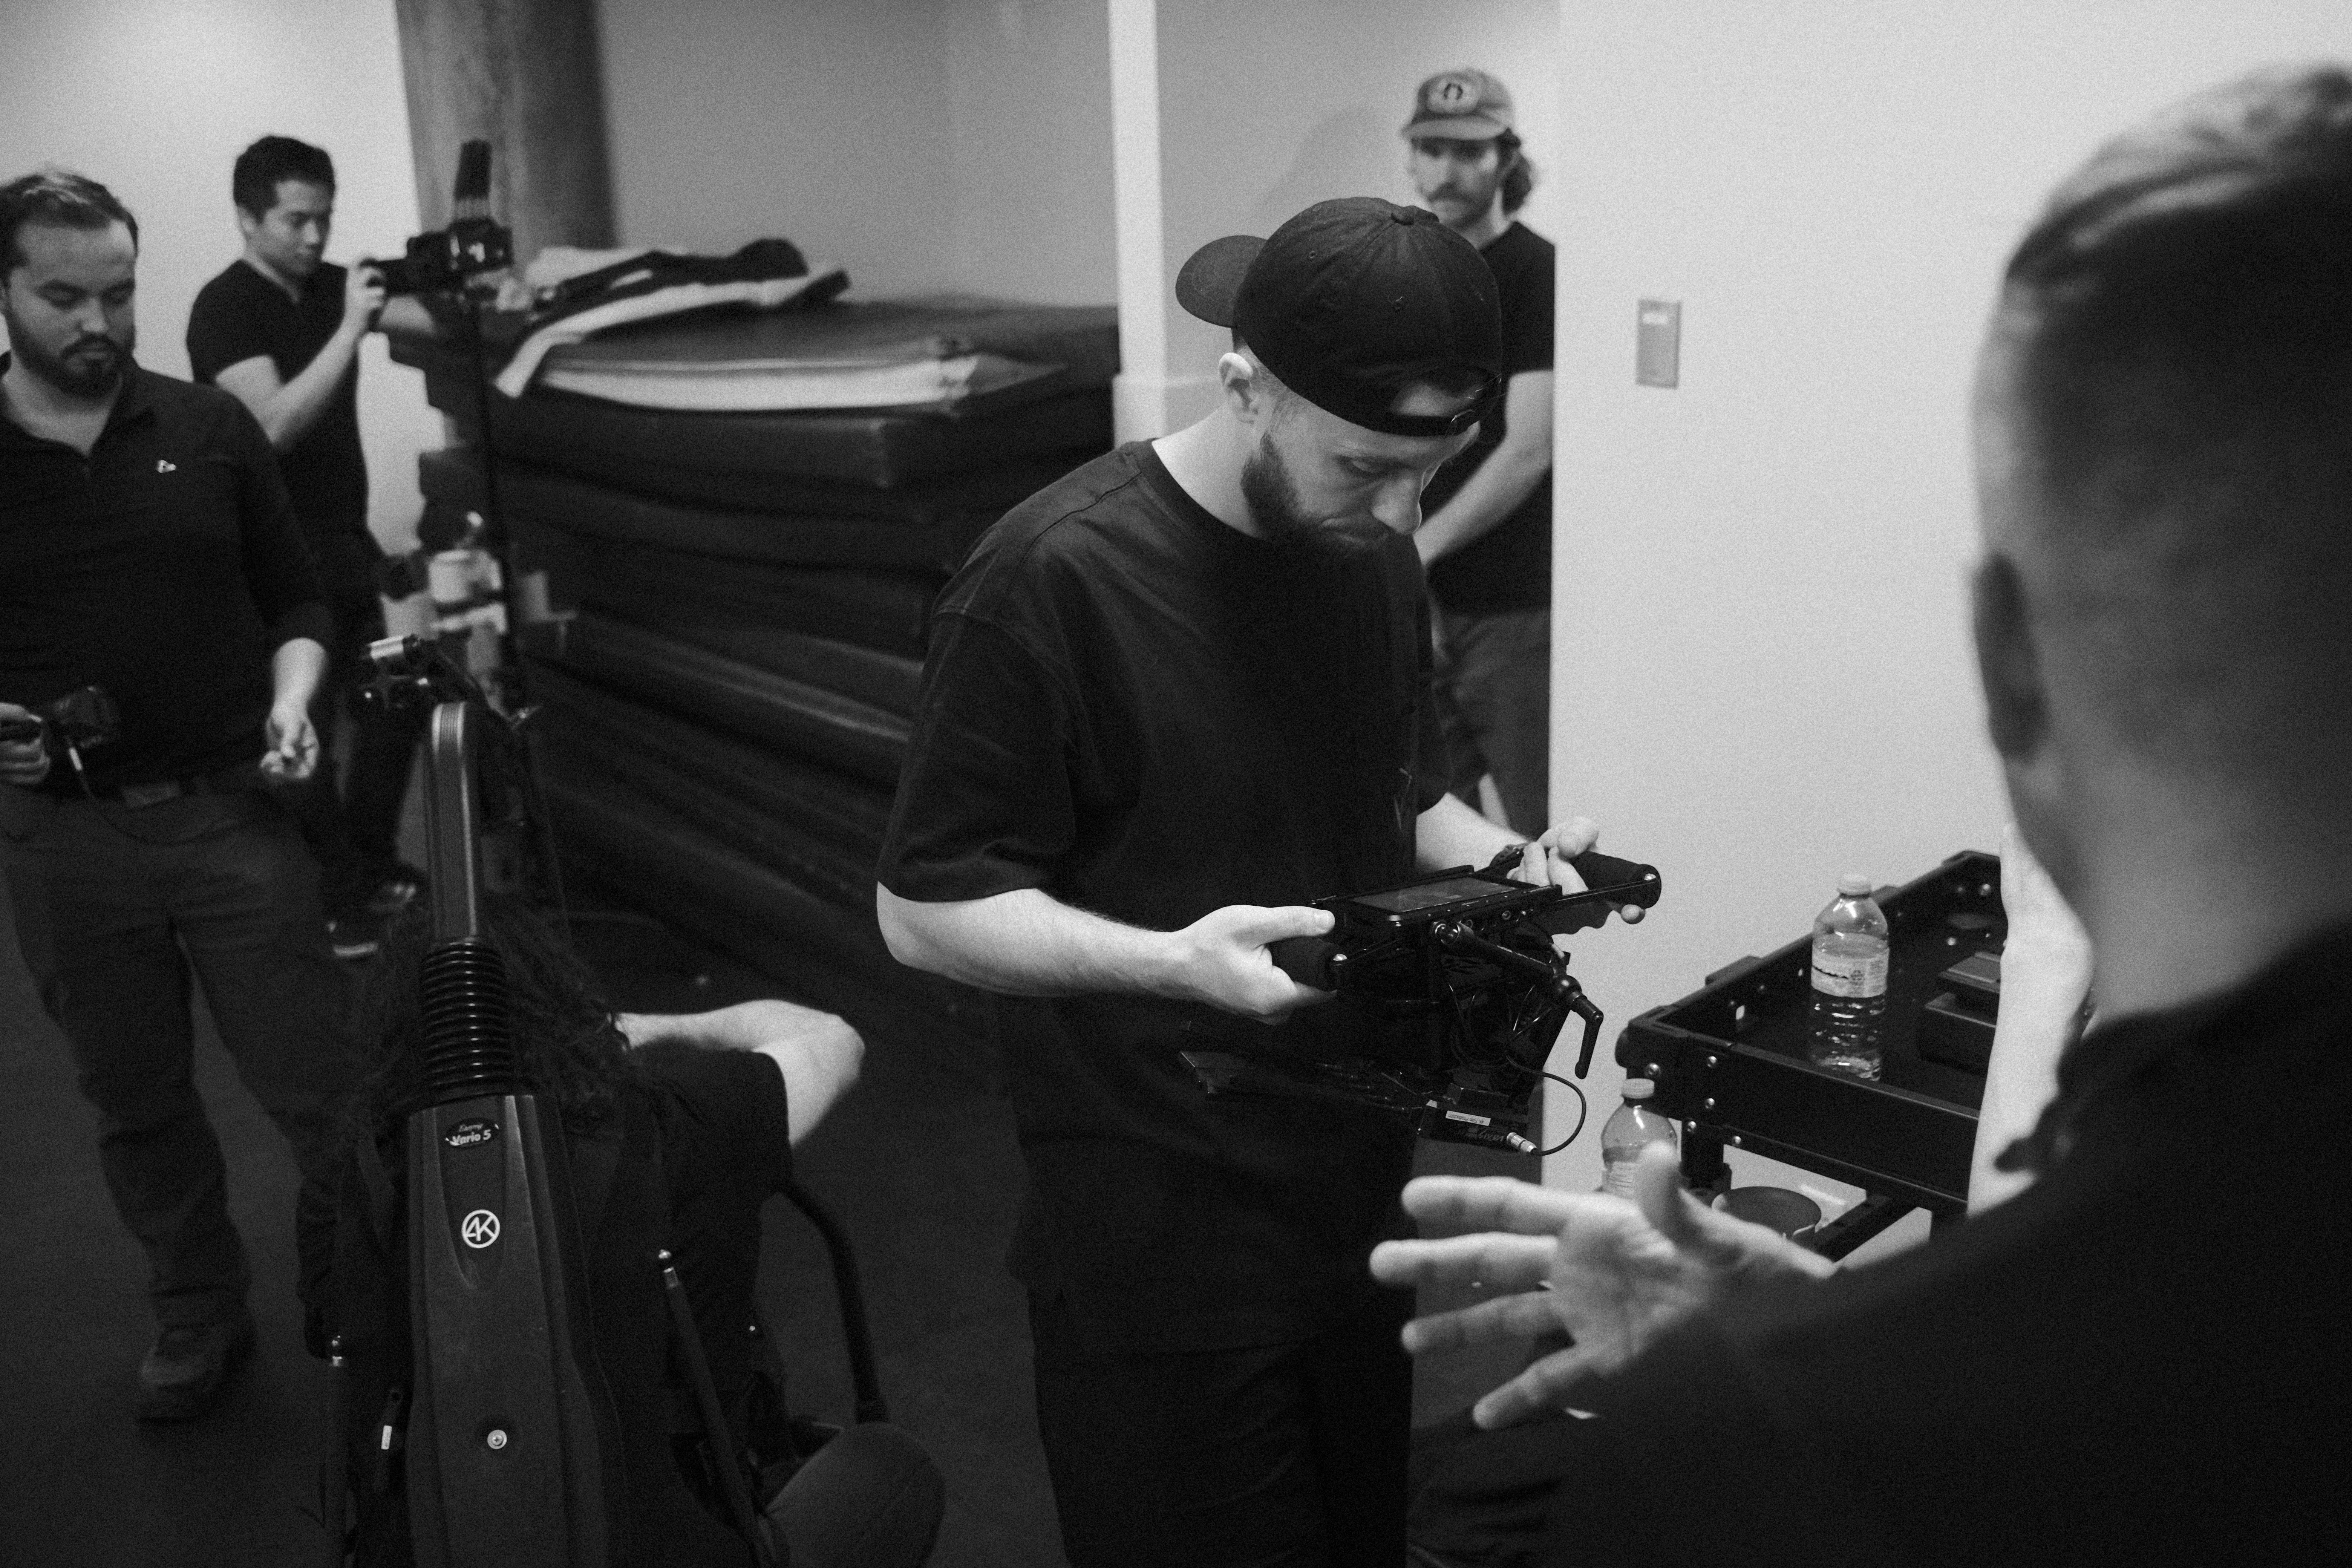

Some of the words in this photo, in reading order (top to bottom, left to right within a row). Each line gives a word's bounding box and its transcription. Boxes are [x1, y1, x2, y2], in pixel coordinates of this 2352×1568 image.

[452, 1132, 481, 1144] Vario
[483, 1129, 491, 1140] 5
[465, 1213, 497, 1243] 4K
